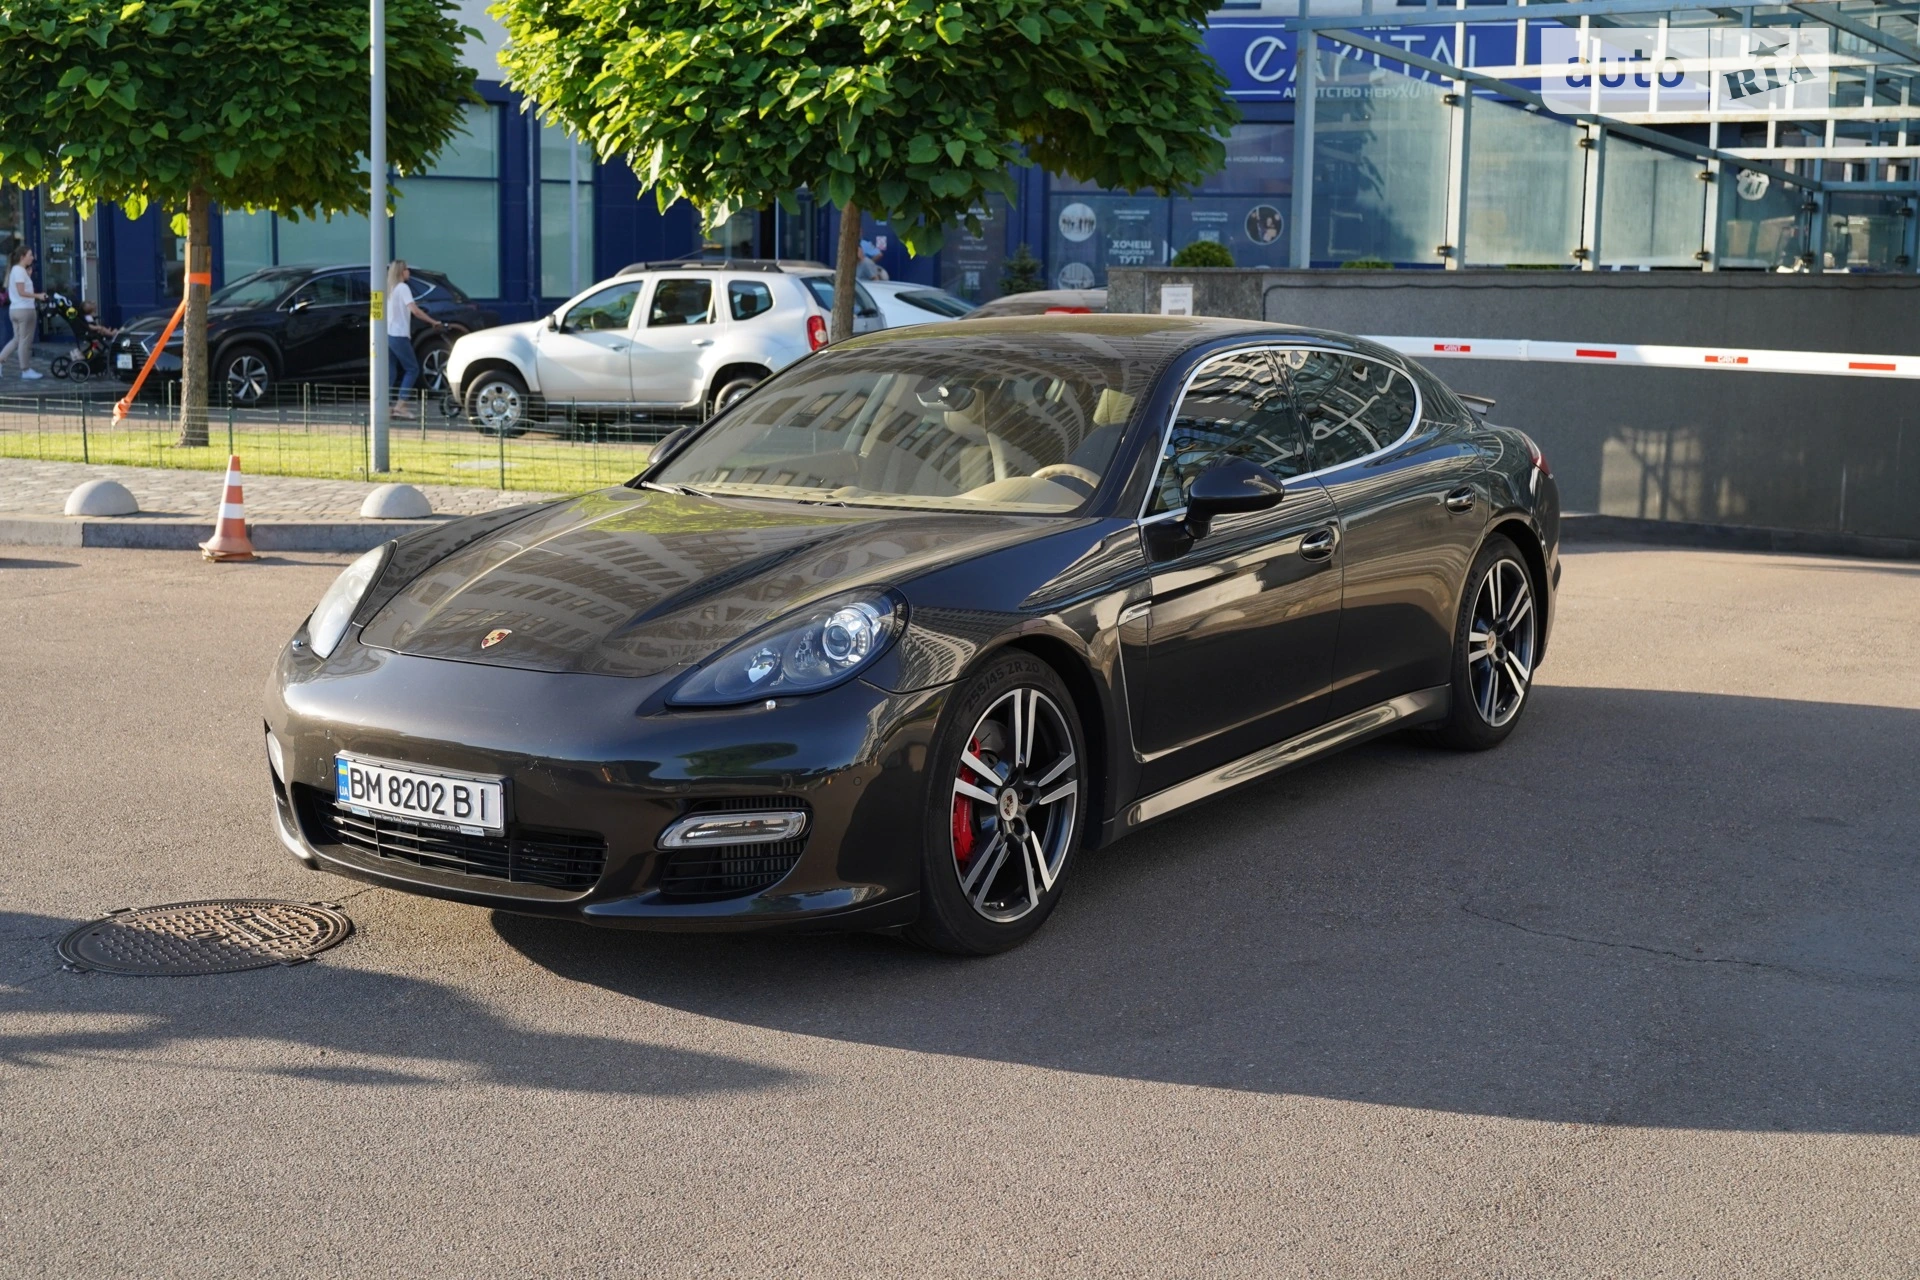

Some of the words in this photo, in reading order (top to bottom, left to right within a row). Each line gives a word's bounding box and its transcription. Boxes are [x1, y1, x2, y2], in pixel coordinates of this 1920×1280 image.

[1112, 240, 1152, 249] ХОЧЕШ
[1119, 256, 1145, 264] ТУТ?
[965, 668, 1004, 712] 255/45
[1006, 661, 1023, 675] ZR
[1025, 661, 1040, 673] 20
[340, 786, 349, 796] UA
[350, 767, 383, 804] BM
[388, 775, 446, 816] 8202
[453, 784, 486, 821] BI
